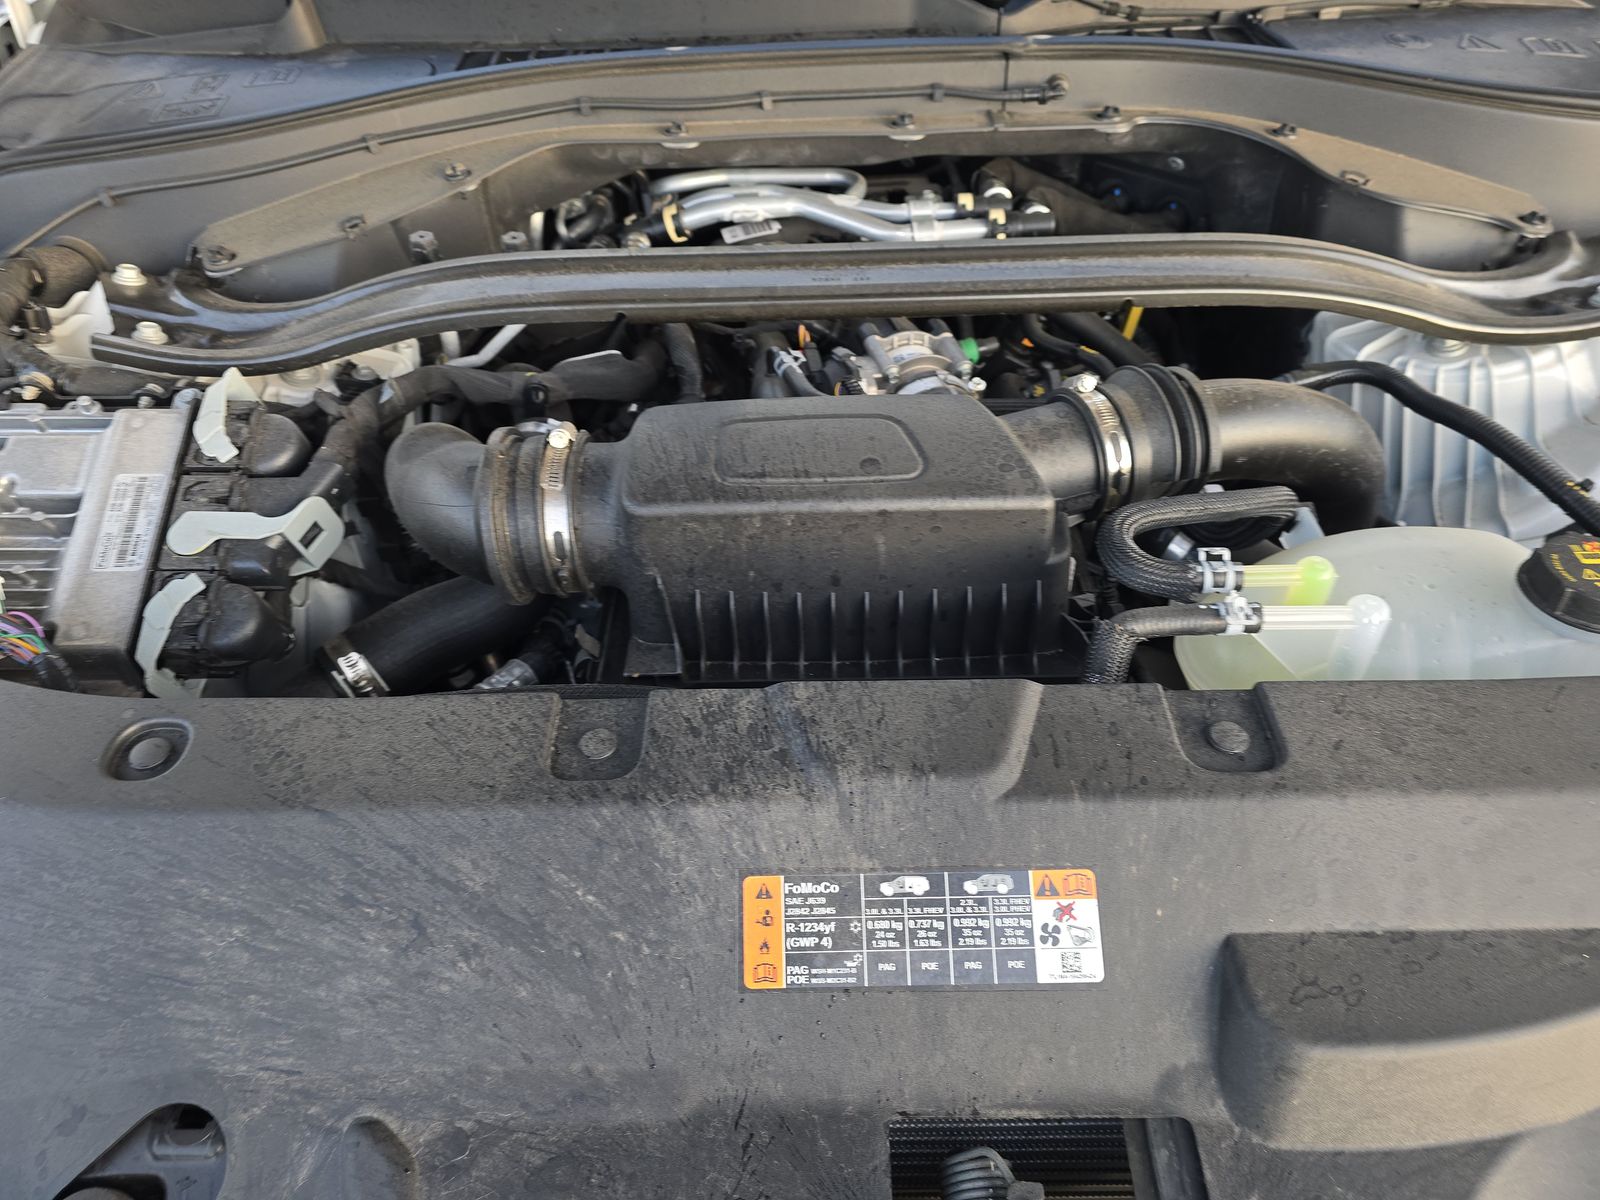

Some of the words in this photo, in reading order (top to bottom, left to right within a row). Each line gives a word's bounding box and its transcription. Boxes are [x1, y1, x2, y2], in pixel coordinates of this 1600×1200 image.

[784, 882, 840, 894] FoMoCo
[785, 897, 805, 905] SAE
[805, 897, 827, 905] J639
[866, 920, 890, 929] 0.680
[891, 920, 903, 931] kg
[908, 919, 931, 929] 0.737
[932, 919, 945, 930] kg
[977, 918, 990, 928] kg
[1019, 917, 1032, 928] kg
[786, 921, 837, 935] R-1234yf
[962, 928, 972, 936] 35
[1004, 928, 1014, 936] 35
[786, 937, 819, 950] (GWP
[820, 936, 833, 949] 4)
[913, 939, 929, 947] 1.63
[929, 939, 942, 947] lbs
[974, 937, 988, 945] lbs
[1016, 937, 1030, 945] lbs
[878, 963, 896, 971] PAG
[921, 962, 940, 970] POE
[964, 961, 983, 969] PAG
[1007, 960, 1026, 969] POE
[786, 966, 809, 975] PAG
[786, 975, 810, 984] POE
